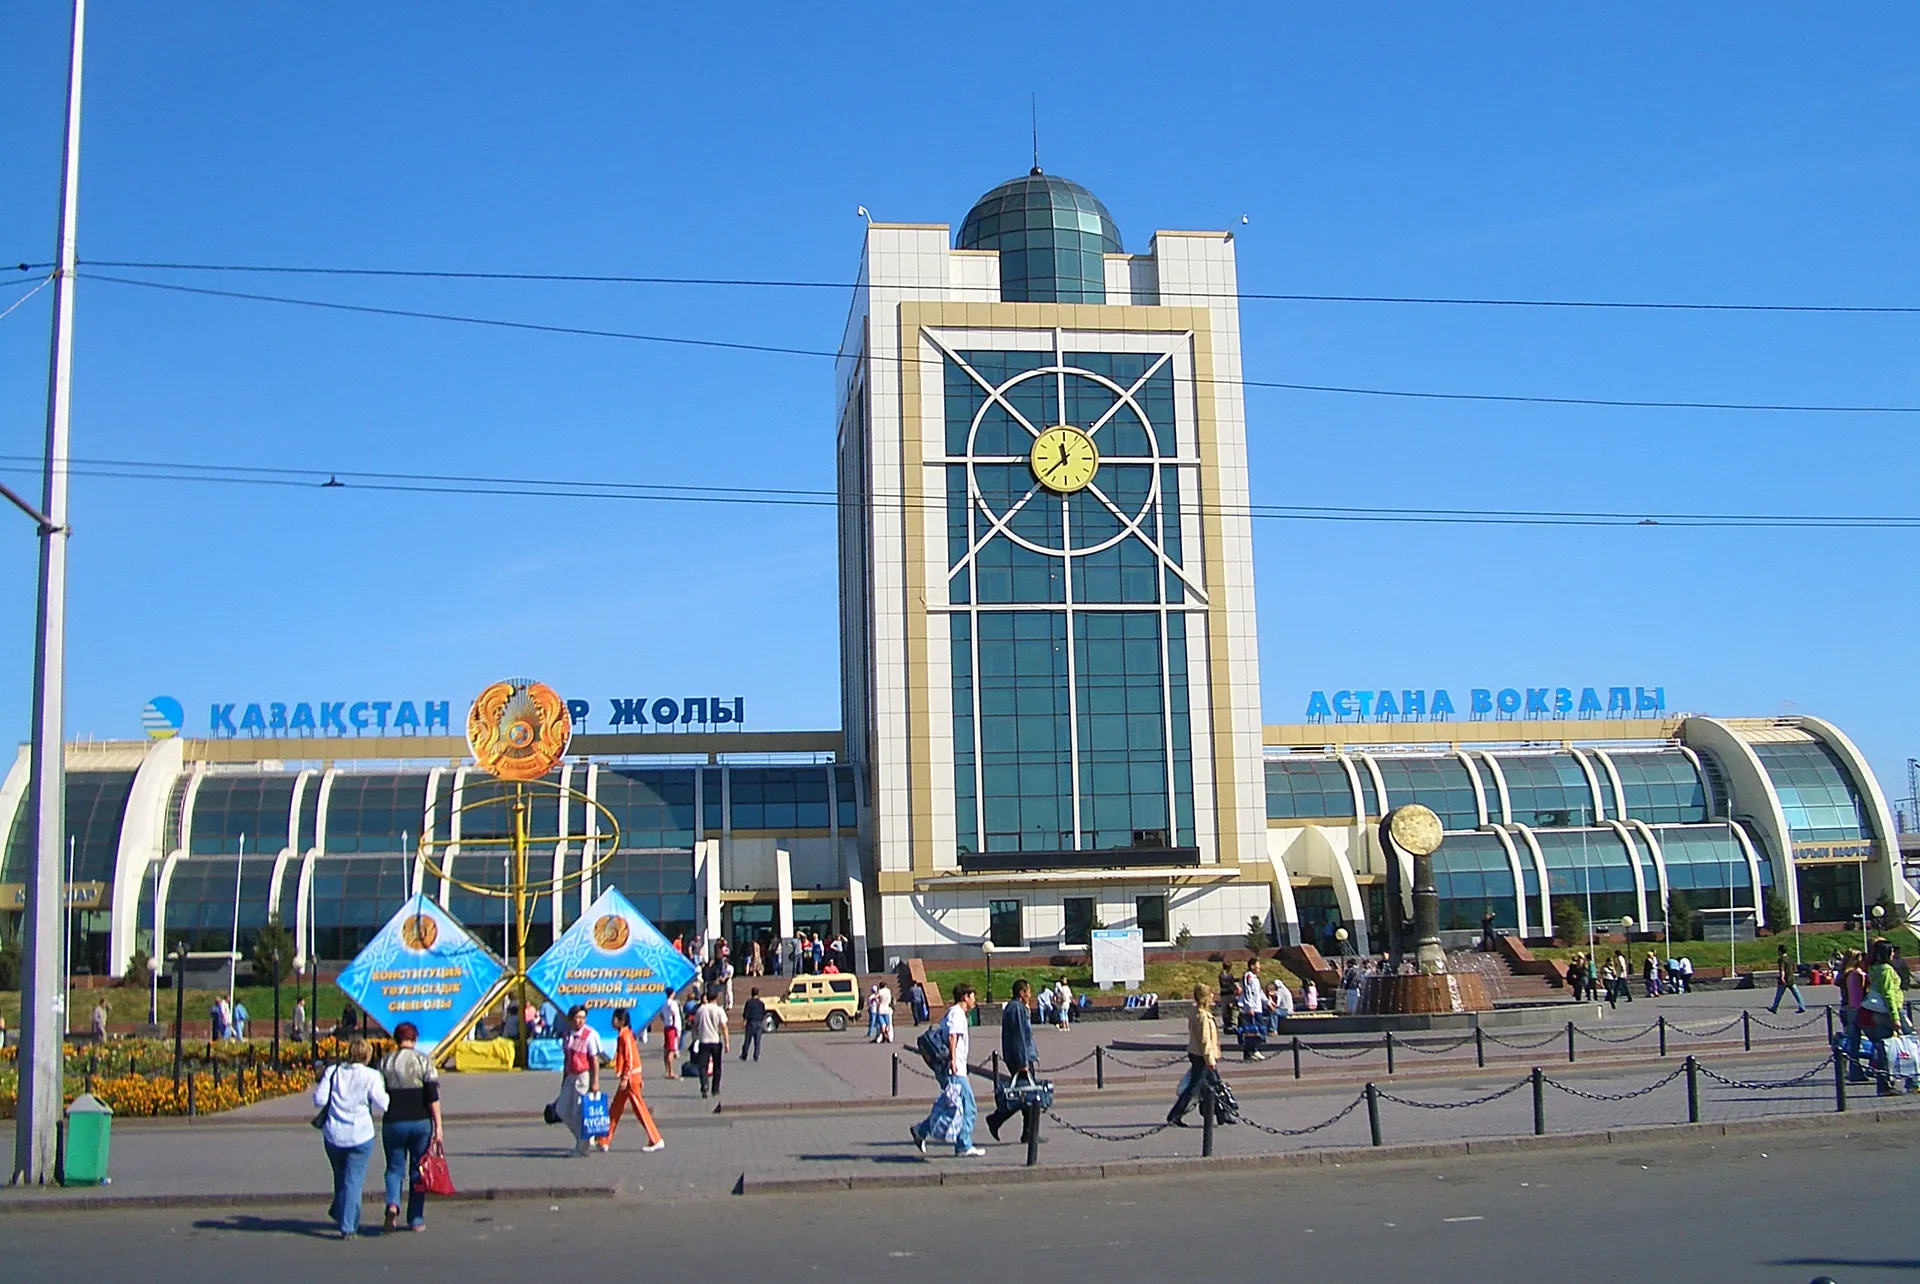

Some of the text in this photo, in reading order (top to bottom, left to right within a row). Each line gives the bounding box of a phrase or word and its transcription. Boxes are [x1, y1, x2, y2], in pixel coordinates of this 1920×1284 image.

[210, 700, 450, 735] ҚАЗАҚСТАН
[608, 697, 744, 725] ЖОЛЫ
[1305, 687, 1666, 717] АСТАНА ВОКЗАЛЫ
[626, 983, 666, 993] ЗАКОН
